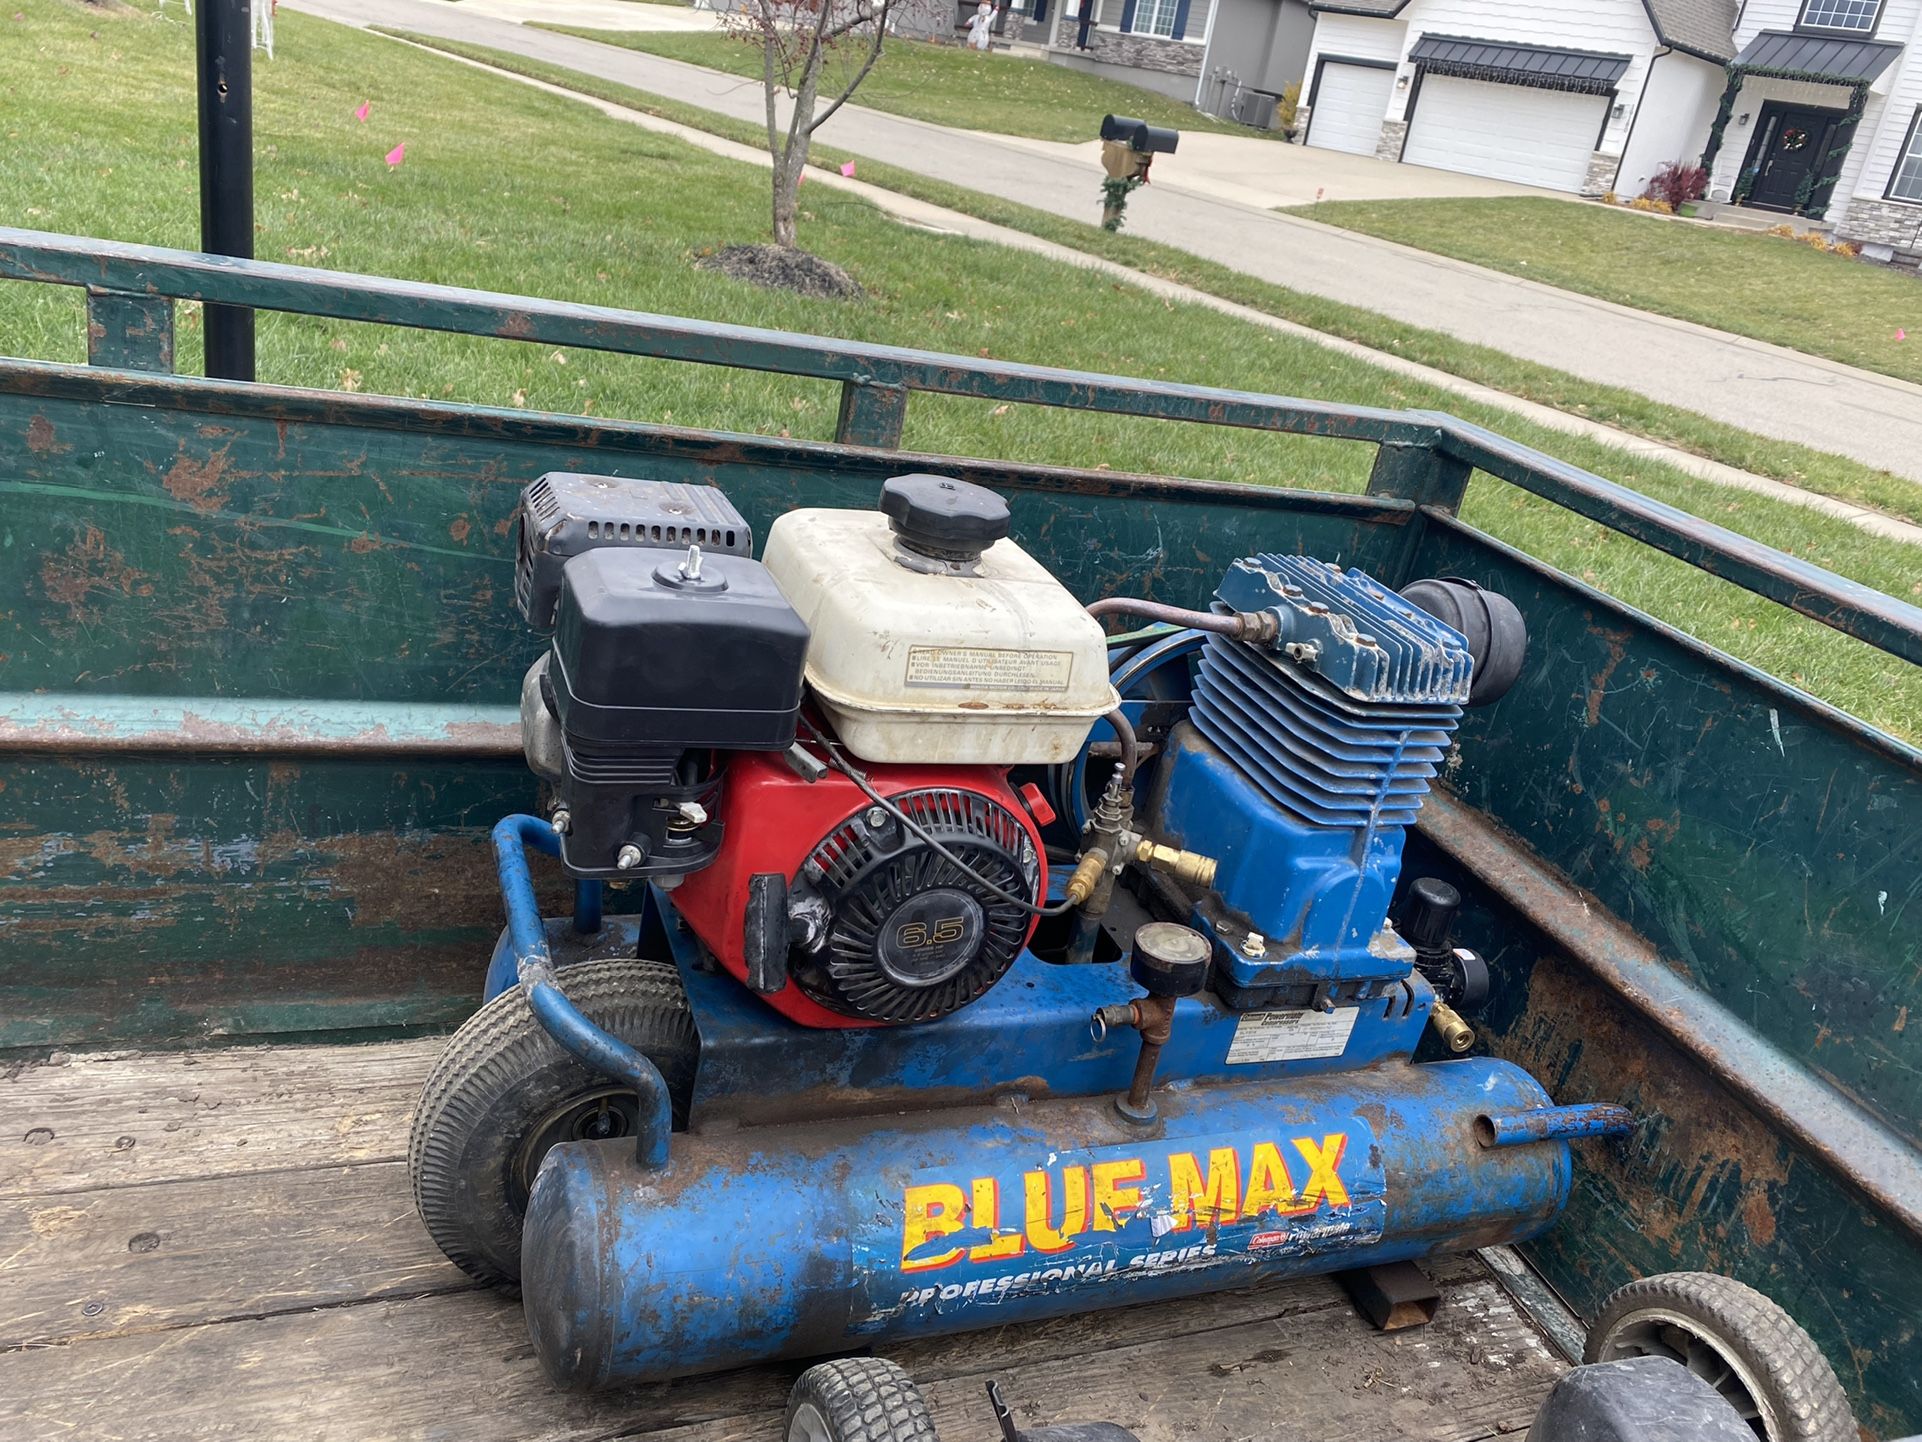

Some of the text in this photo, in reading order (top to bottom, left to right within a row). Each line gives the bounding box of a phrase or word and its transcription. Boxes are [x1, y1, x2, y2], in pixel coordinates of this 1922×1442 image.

[896, 917, 964, 948] 6.5
[900, 1132, 1350, 1273] BLUE MAX
[1129, 1245, 1218, 1267] SERIES
